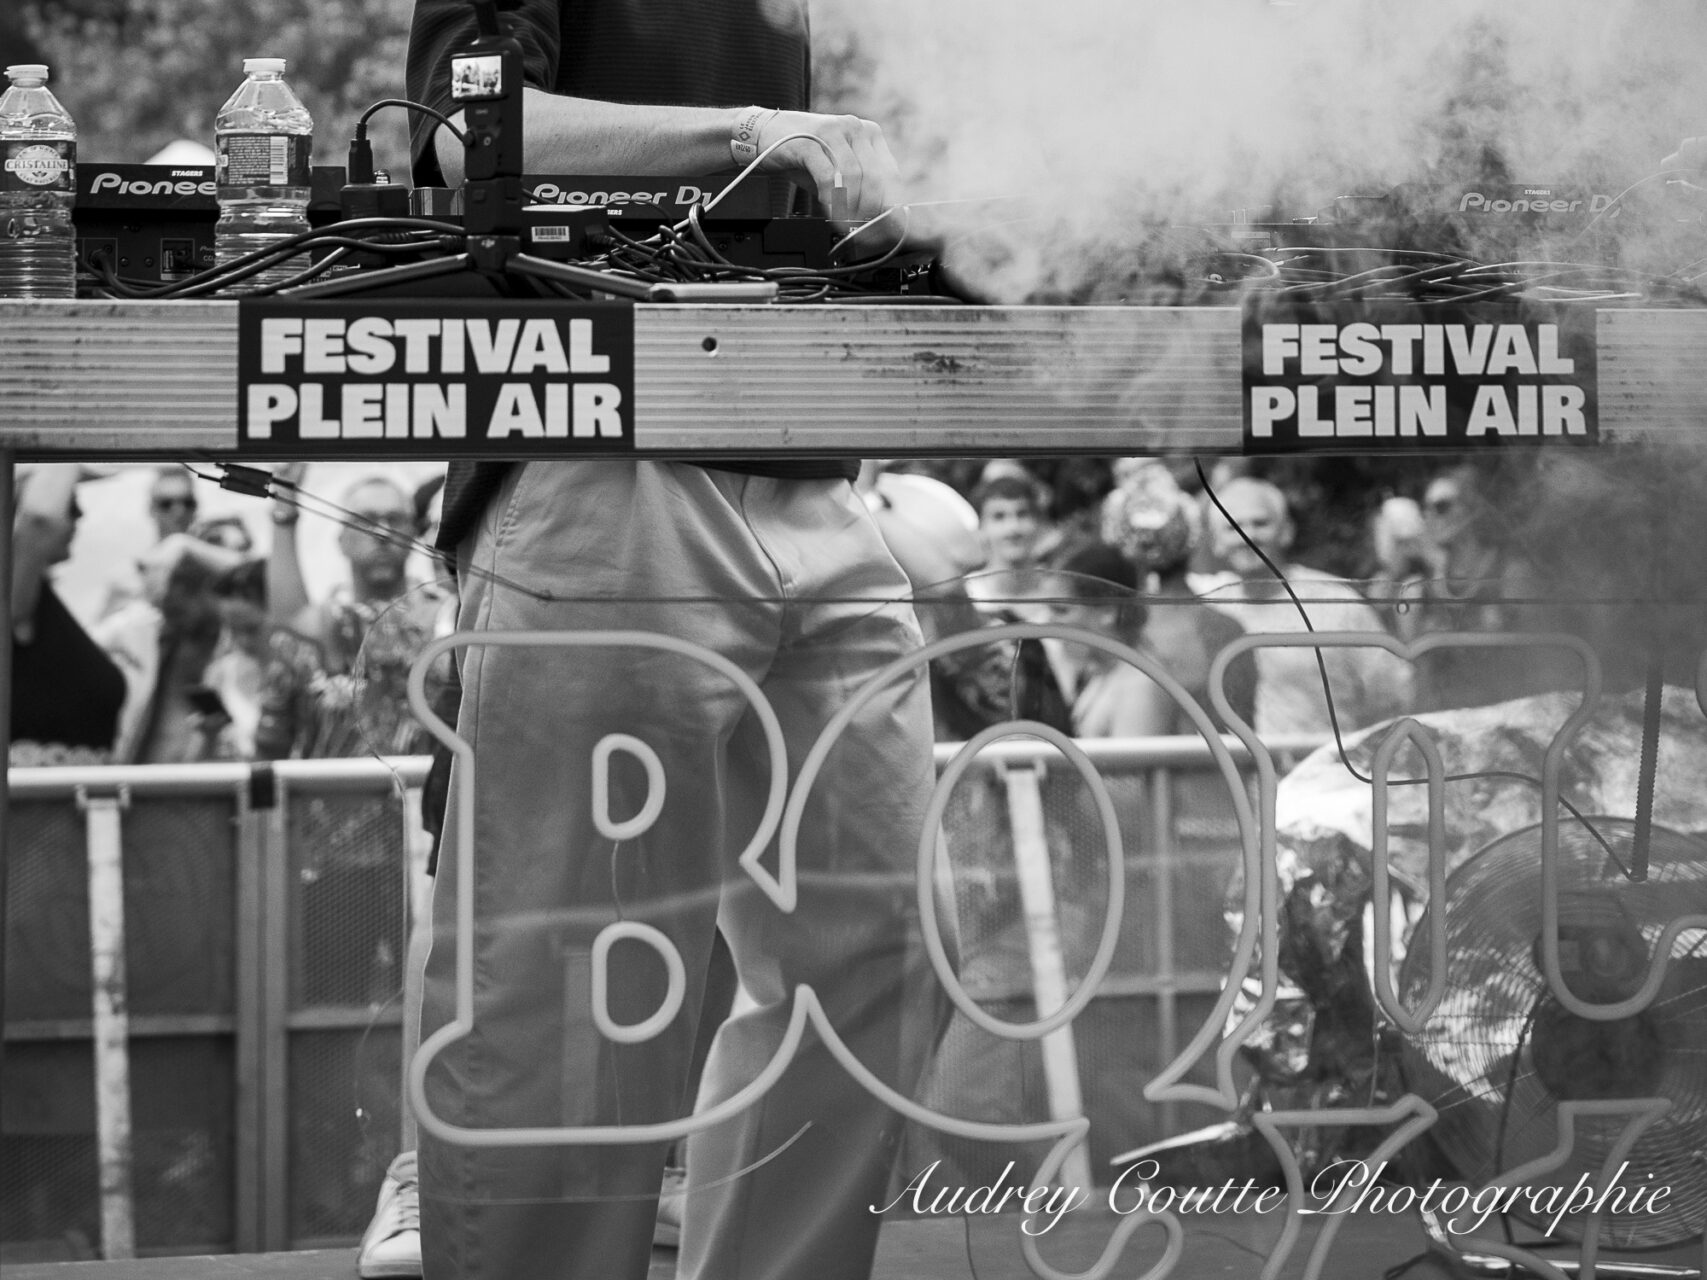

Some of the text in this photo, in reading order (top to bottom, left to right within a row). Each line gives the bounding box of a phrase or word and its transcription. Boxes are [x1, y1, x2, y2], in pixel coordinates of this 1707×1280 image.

[6, 160, 68, 169] CRISTALINE
[89, 172, 217, 196] Pionee
[530, 183, 667, 205] Pioneer
[1458, 192, 1582, 213] Pioneer
[261, 318, 610, 375] FESTIVAL
[1262, 323, 1574, 376] FESTIVAL
[247, 383, 623, 439] PLEIN AIR
[1251, 385, 1587, 437] PLEIN AIR
